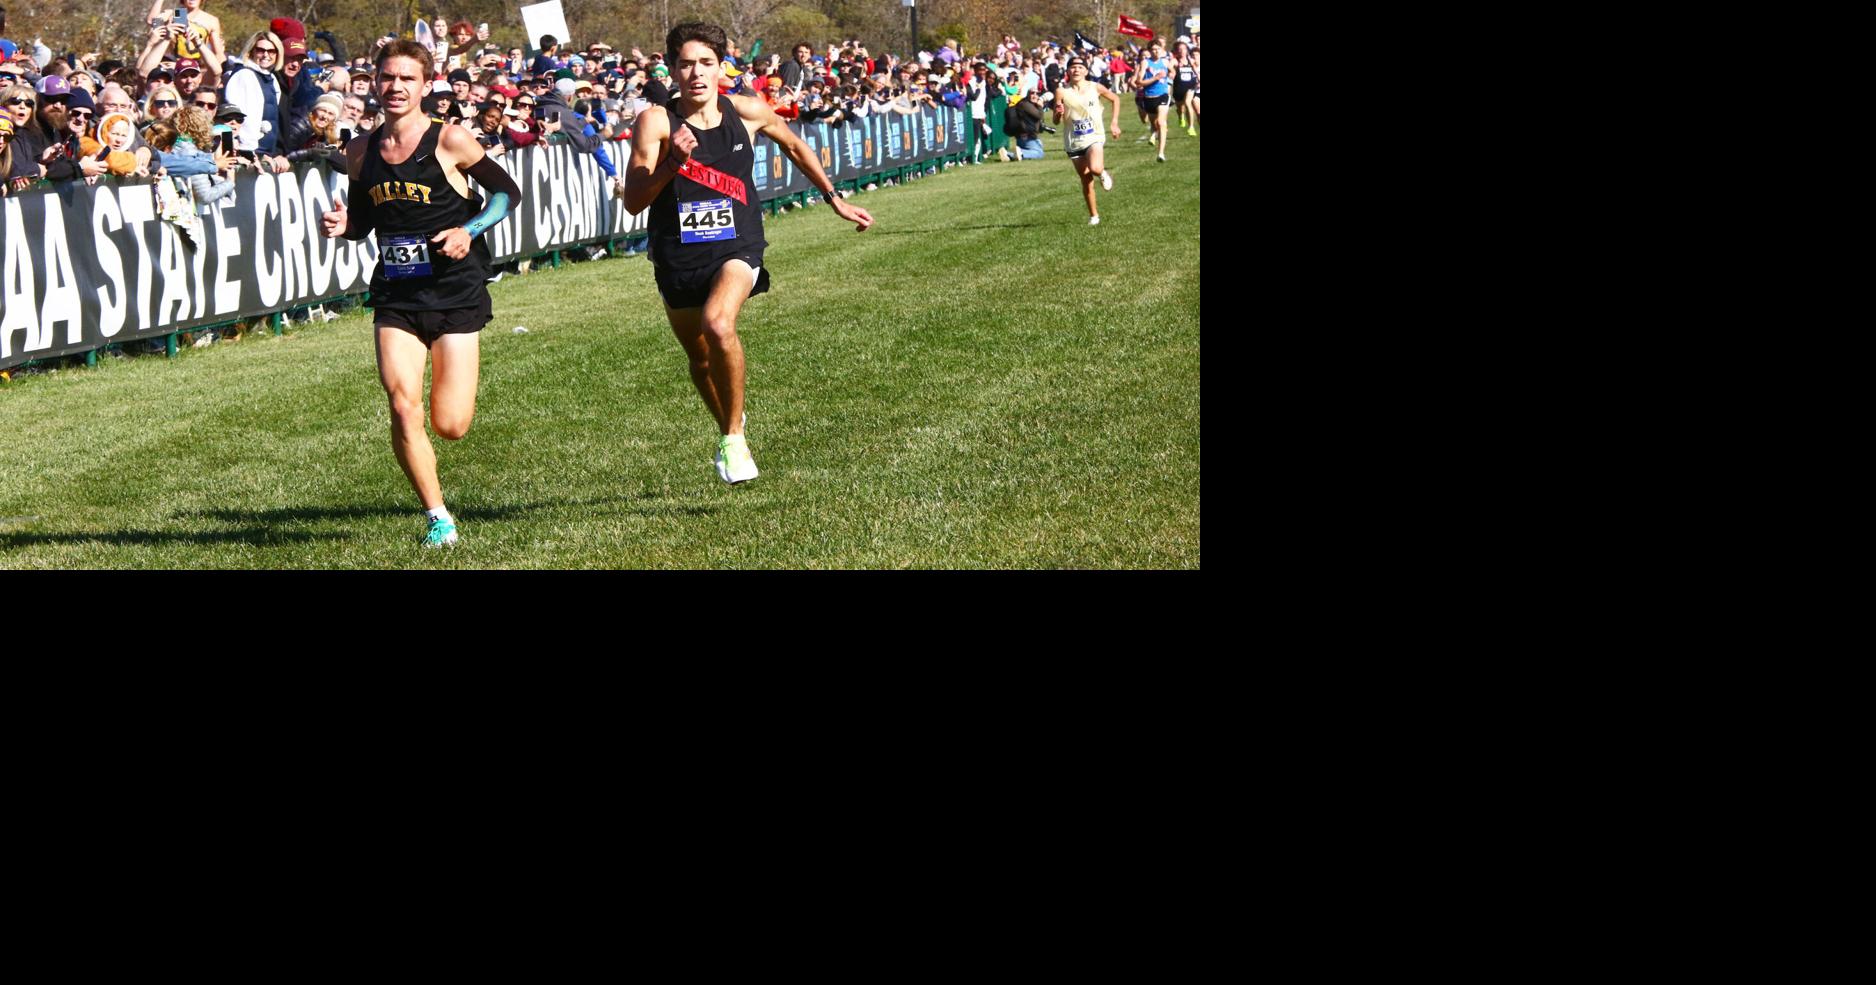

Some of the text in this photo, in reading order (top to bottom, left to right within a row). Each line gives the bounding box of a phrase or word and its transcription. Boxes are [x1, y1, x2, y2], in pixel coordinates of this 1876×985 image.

[687, 163, 742, 197] ESTVIEW
[368, 181, 431, 207] VALLEY
[682, 209, 732, 229] 445
[92, 184, 242, 338] STATE
[532, 138, 651, 250] CHAMIO
[384, 244, 425, 264] 431
